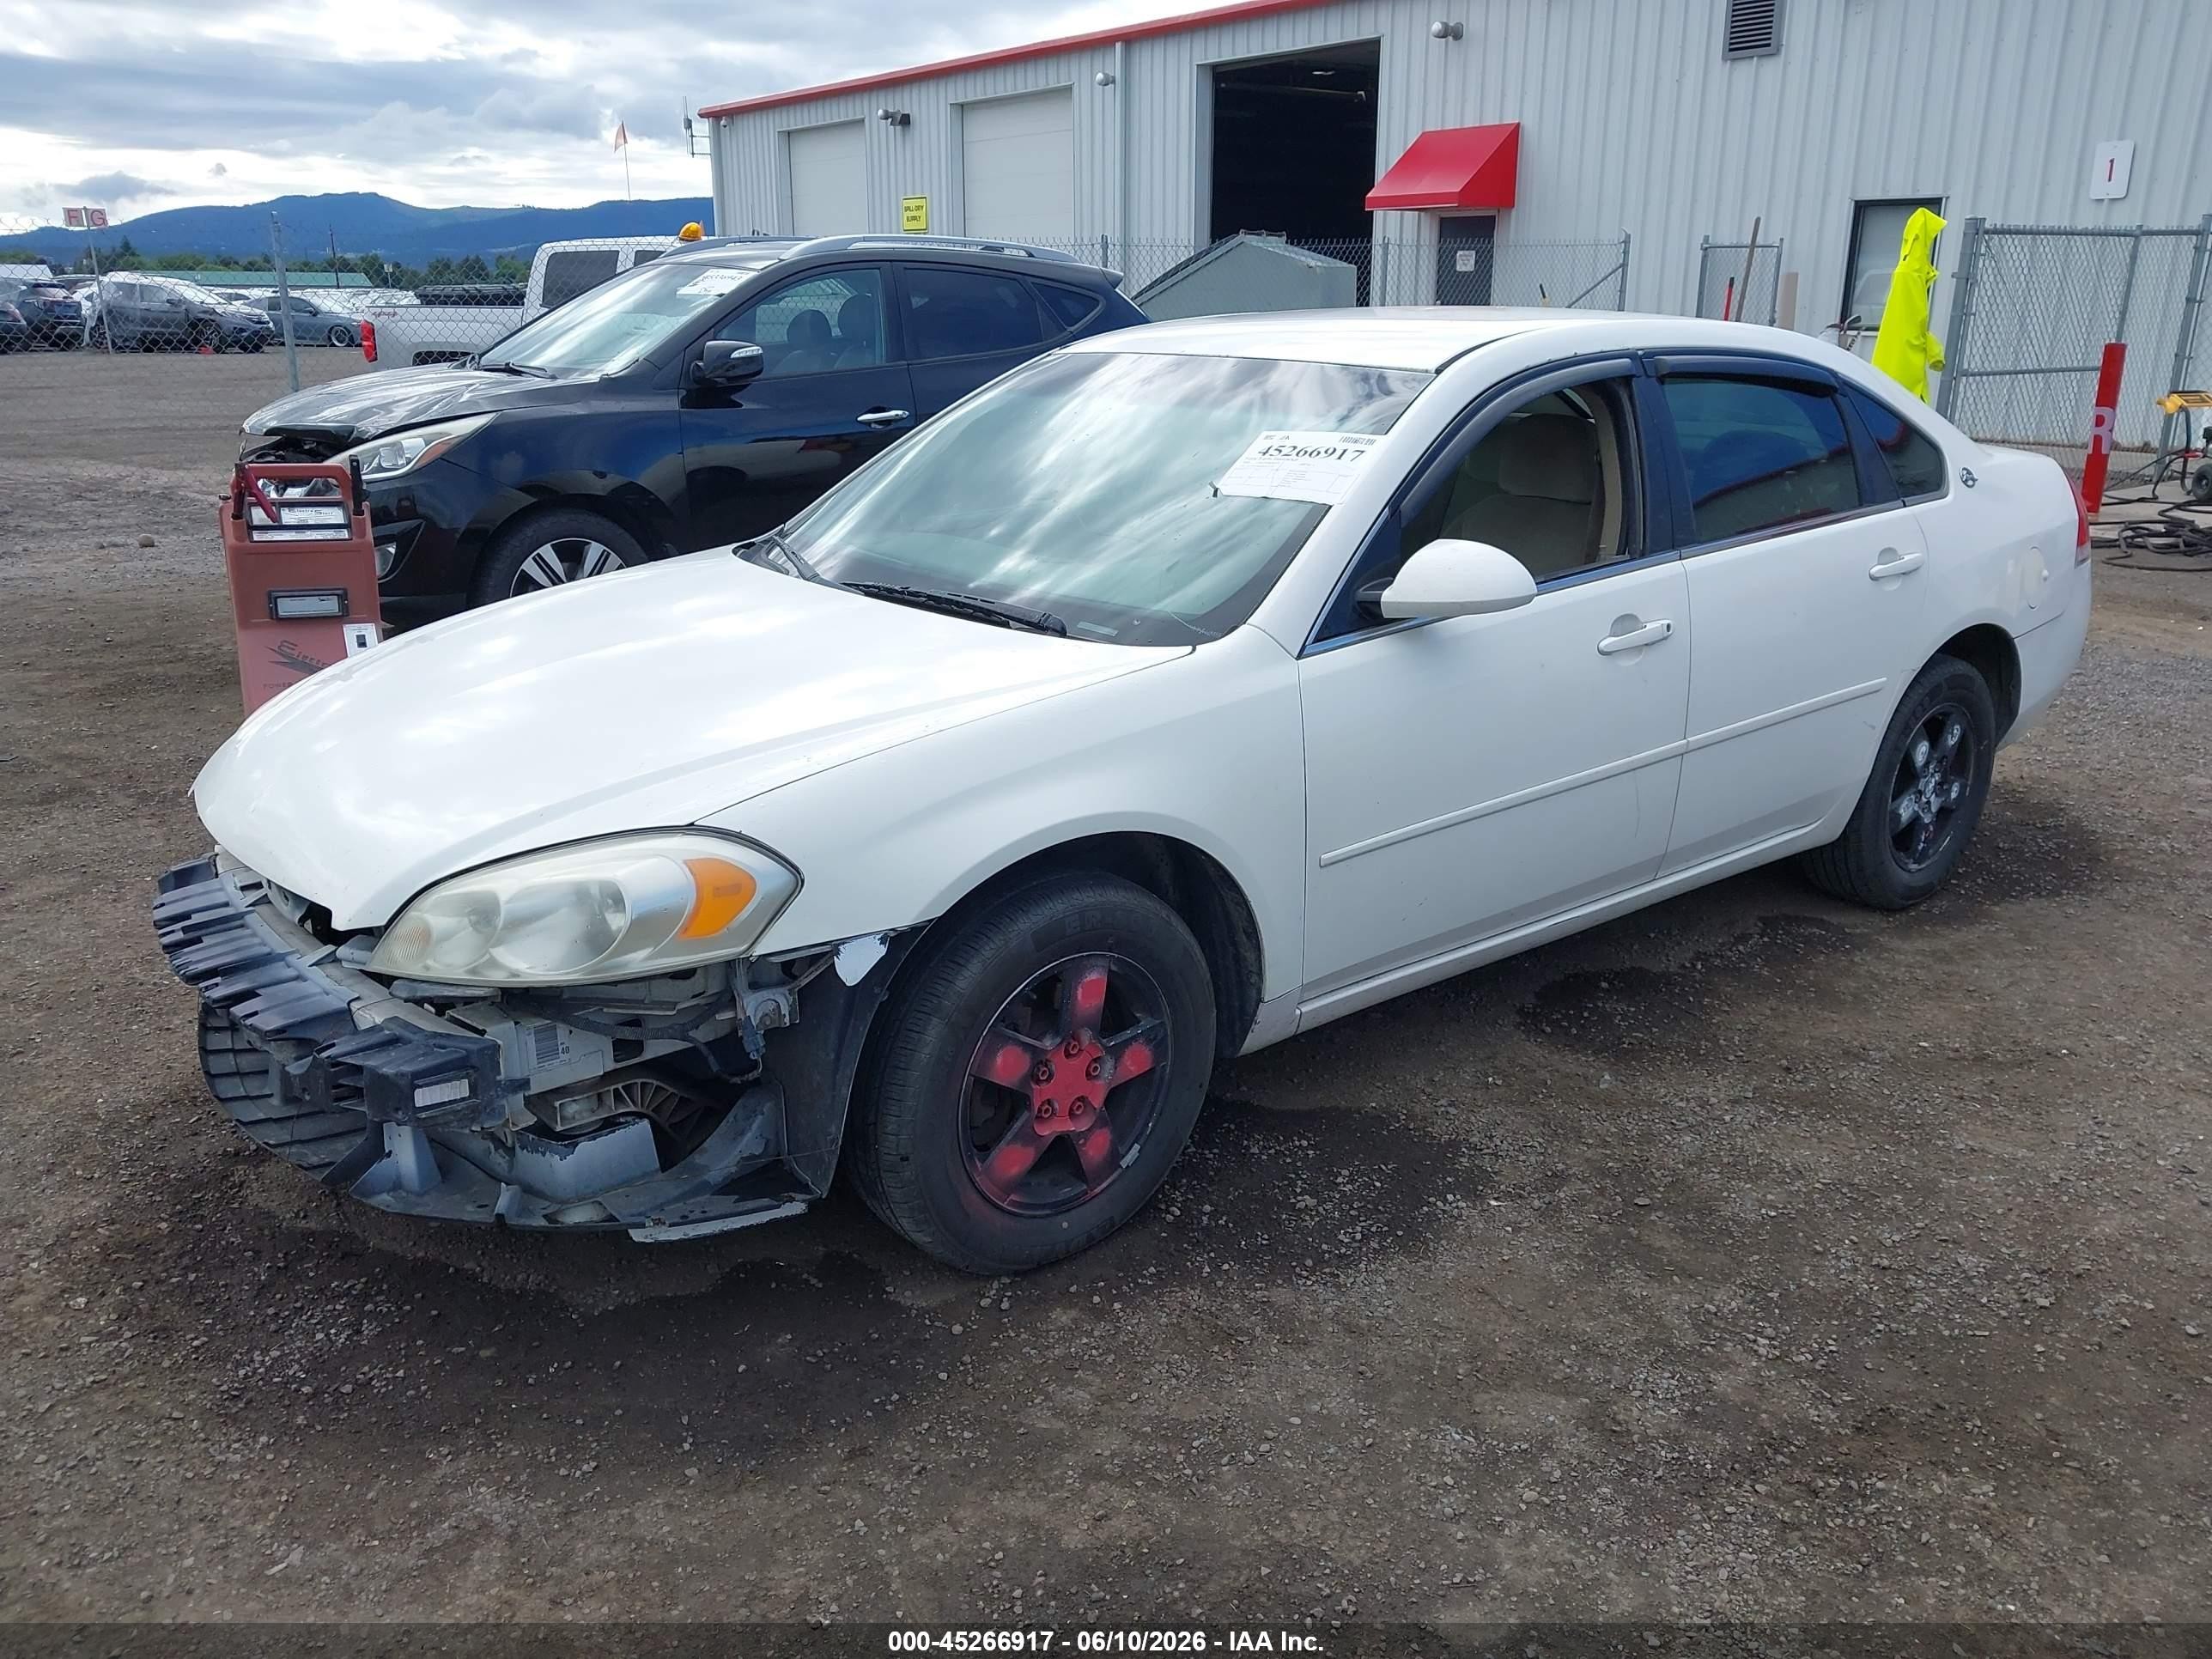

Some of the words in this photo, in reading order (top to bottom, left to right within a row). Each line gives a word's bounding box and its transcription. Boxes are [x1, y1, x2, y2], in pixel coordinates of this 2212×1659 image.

[2107, 157, 2115, 182] 1
[67, 210, 78, 225] F
[90, 210, 104, 226] G
[2087, 406, 2115, 454] R
[1258, 445, 1365, 462] 45266917
[277, 640, 331, 667] Electr
[561, 1046, 570, 1055] 40
